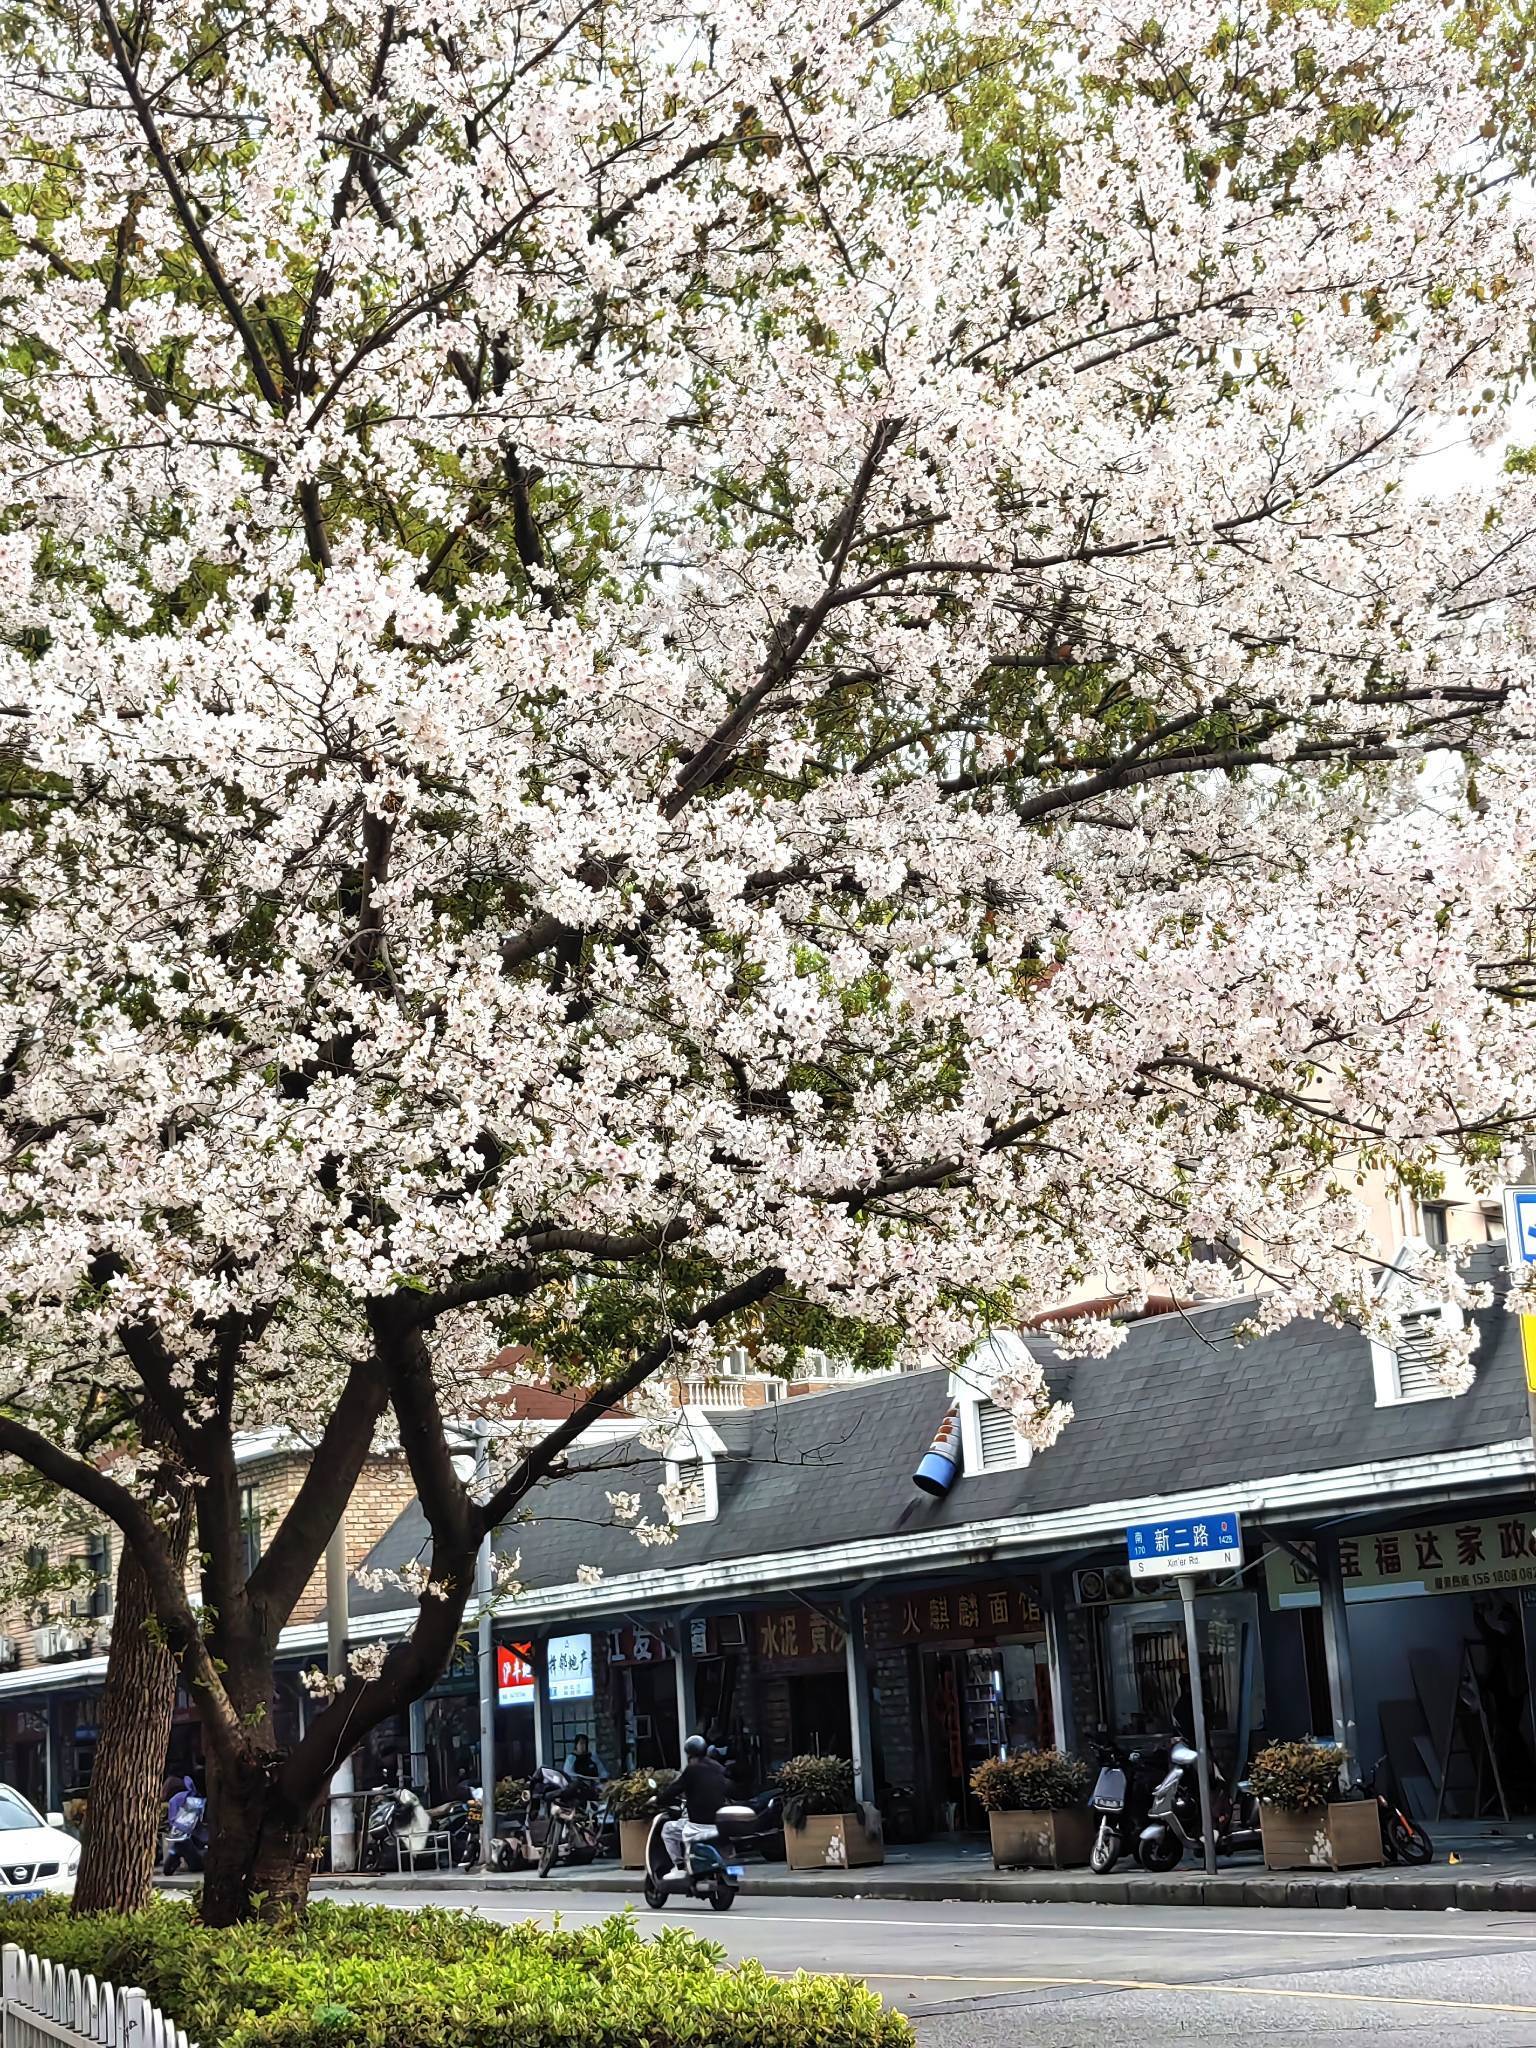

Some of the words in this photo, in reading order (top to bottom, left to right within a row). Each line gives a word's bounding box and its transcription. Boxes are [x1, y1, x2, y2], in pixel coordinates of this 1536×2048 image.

[1154, 1523, 1209, 1552] 新二路
[1134, 1545, 1146, 1556] 170
[1224, 1551, 1232, 1563] N
[1138, 1562, 1145, 1573] S
[761, 1615, 799, 1659] 水泥
